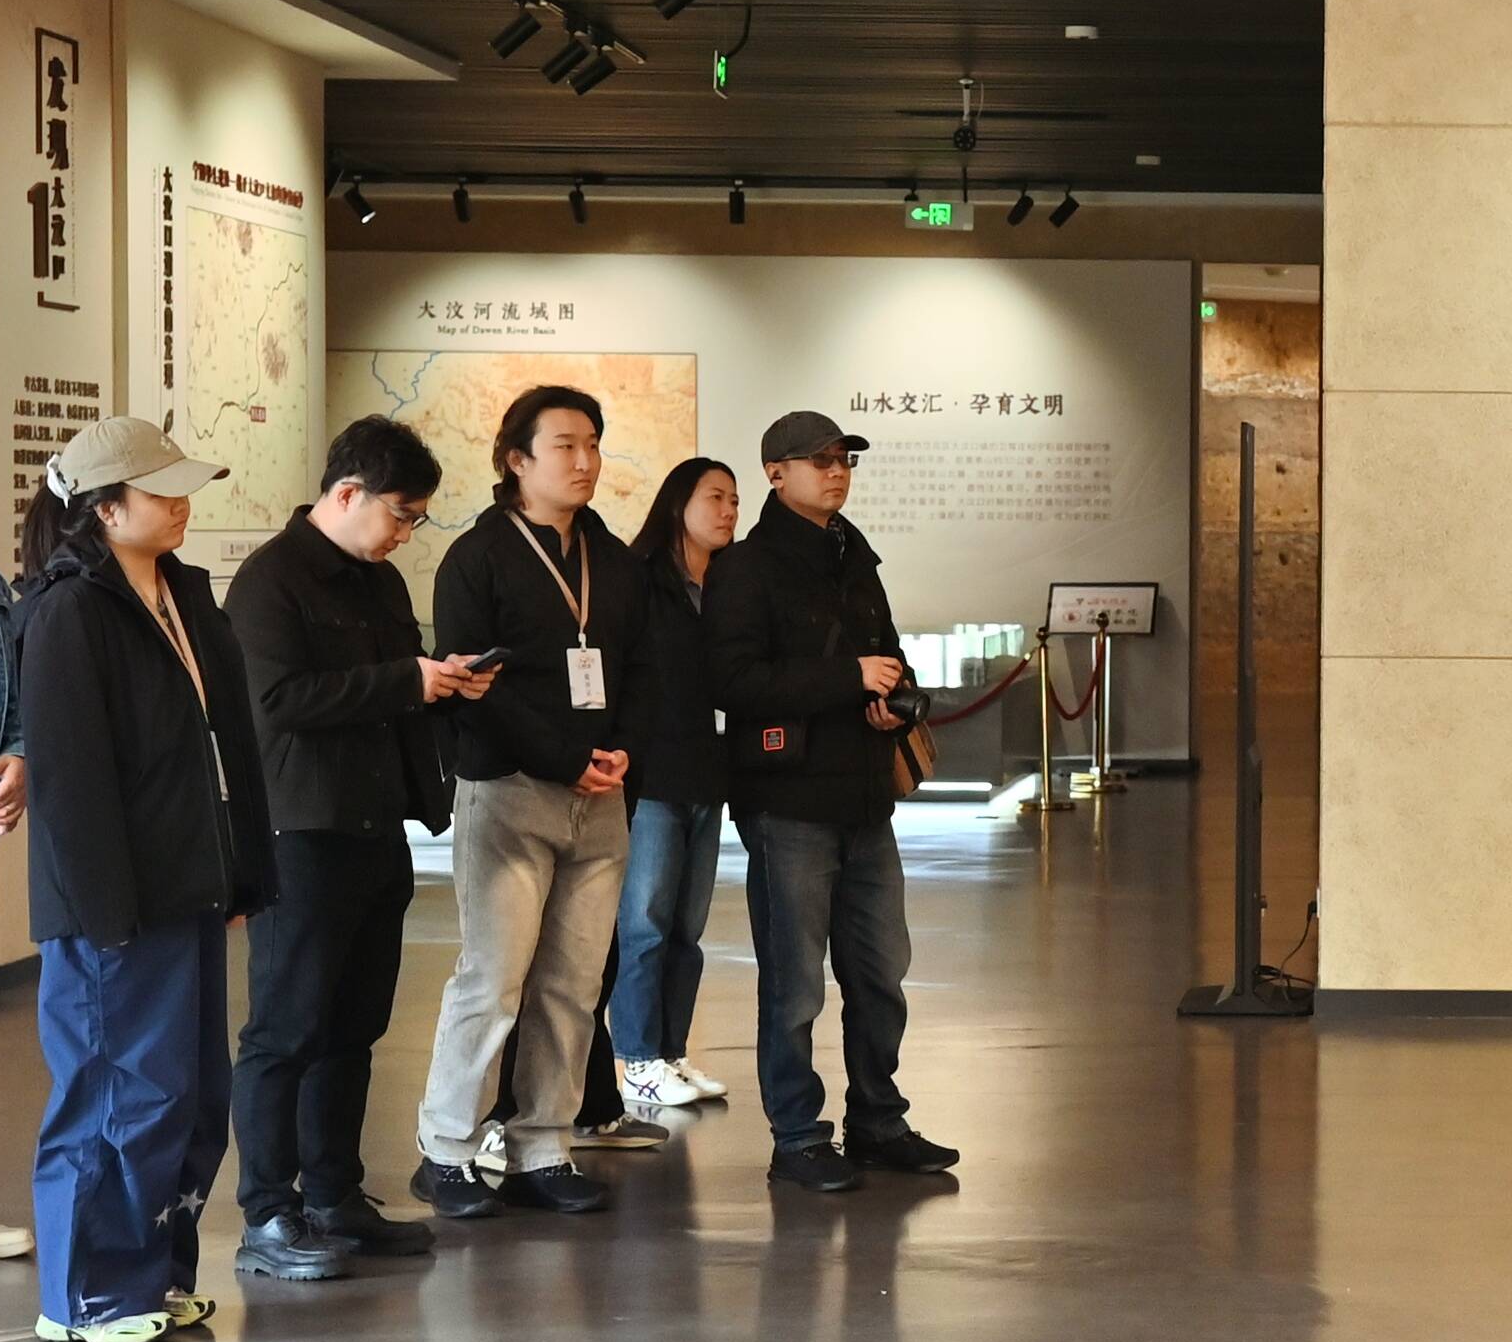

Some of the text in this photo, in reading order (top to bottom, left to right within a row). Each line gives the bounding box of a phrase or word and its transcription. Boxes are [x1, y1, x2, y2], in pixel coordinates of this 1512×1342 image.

[27, 182, 49, 278] 1
[418, 300, 574, 321] 大汶河流域图
